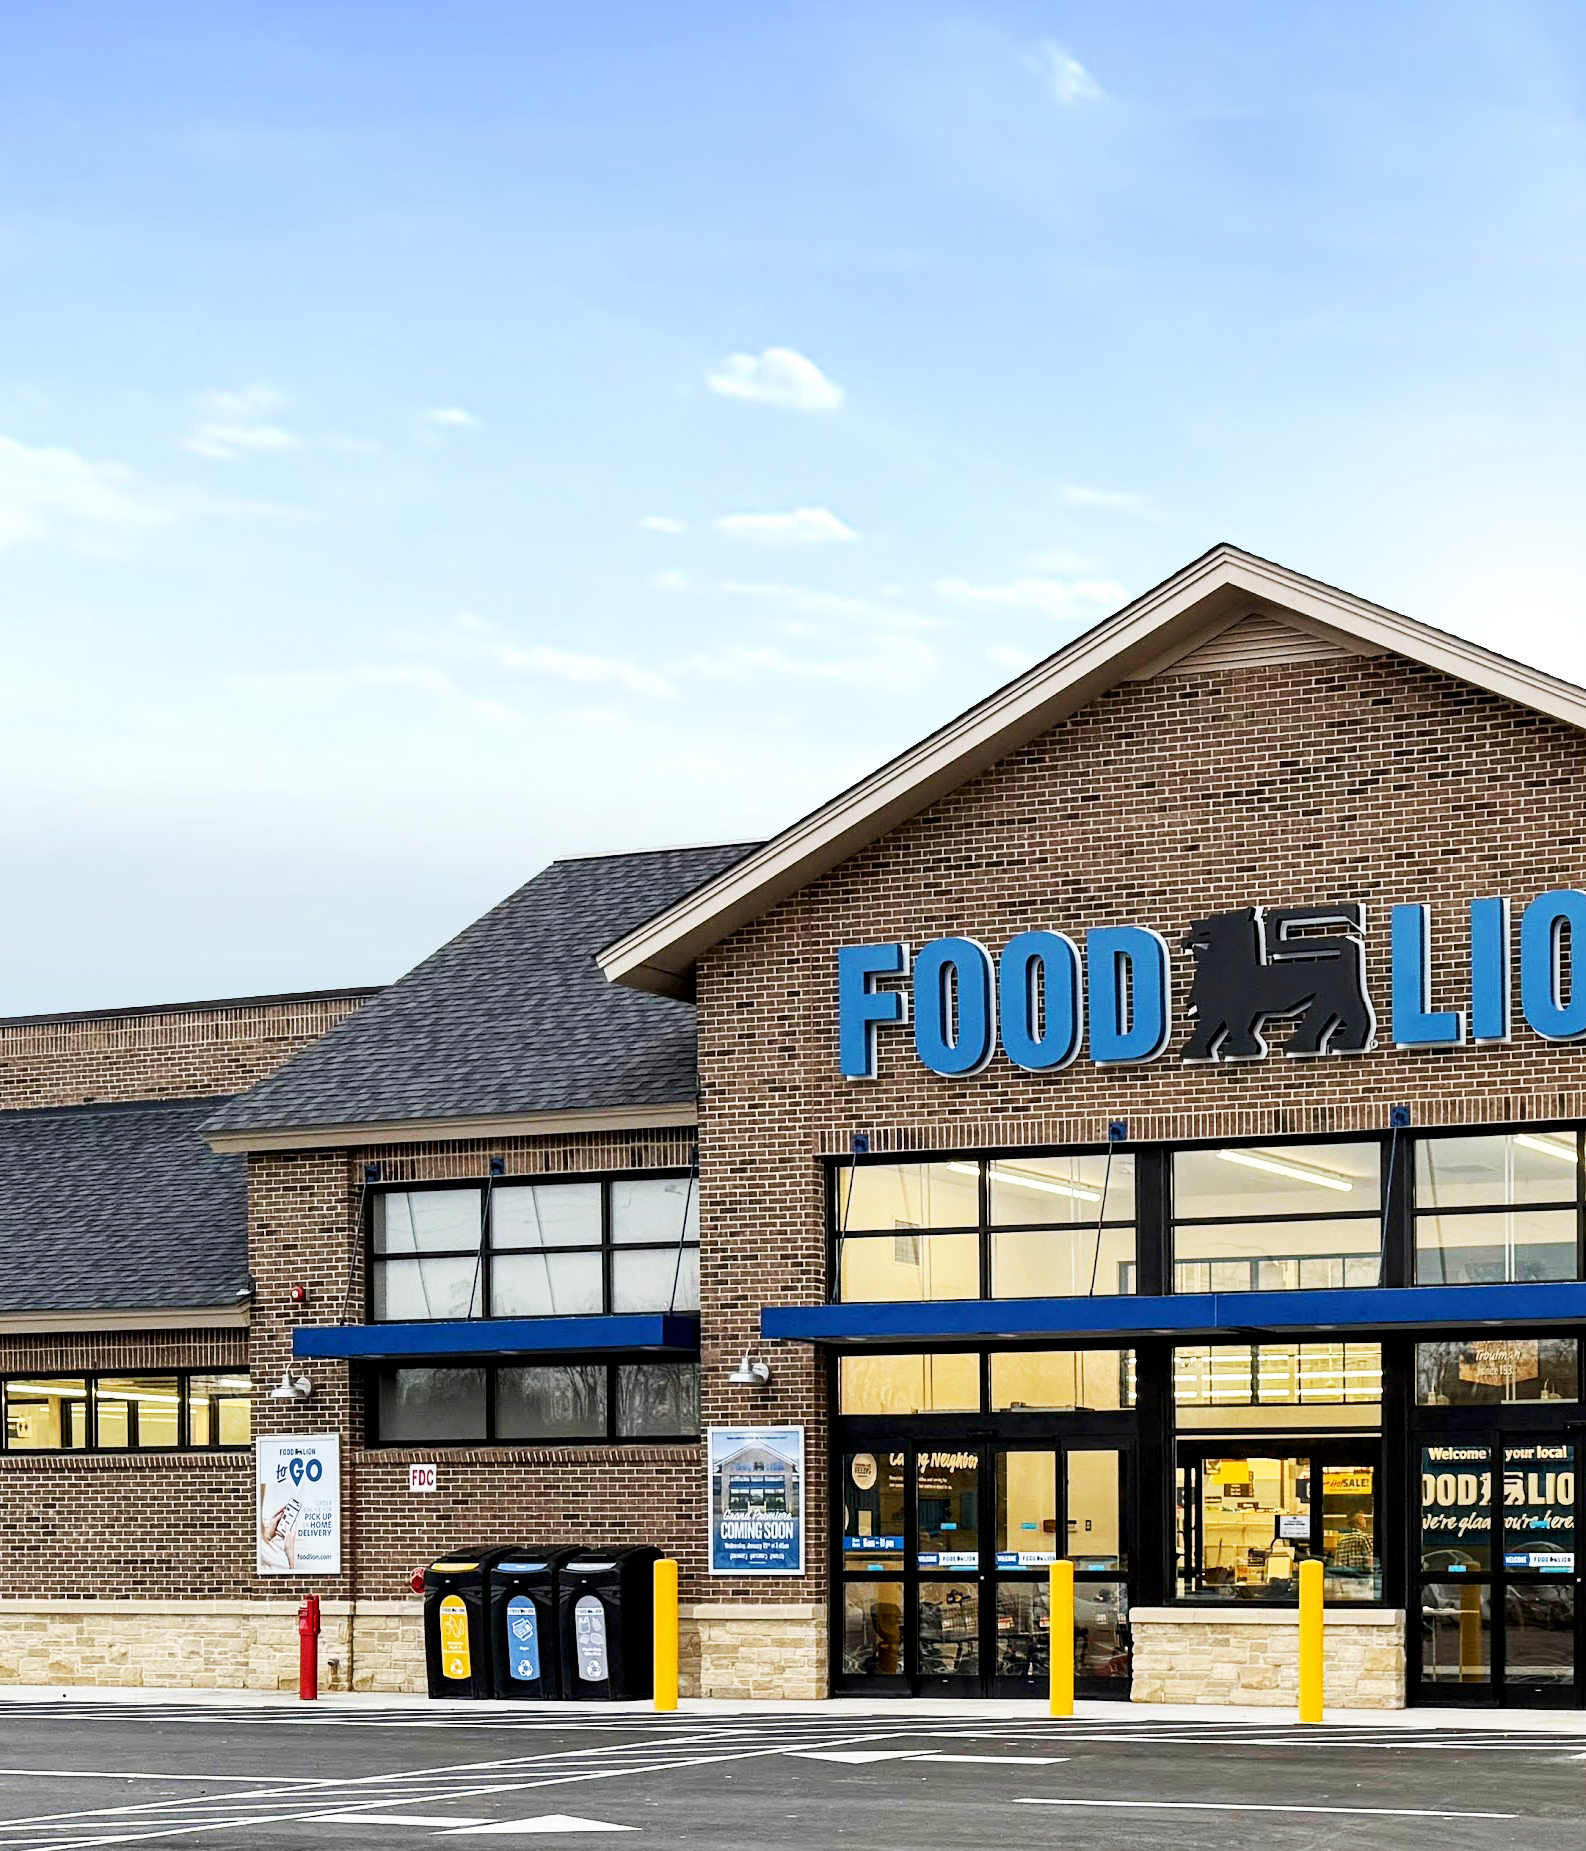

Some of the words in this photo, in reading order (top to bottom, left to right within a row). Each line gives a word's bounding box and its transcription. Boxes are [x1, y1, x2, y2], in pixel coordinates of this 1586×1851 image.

[836, 925, 1173, 1081] FOOD
[279, 1448, 294, 1456] FOOD
[301, 1448, 316, 1456] LION
[1428, 1447, 1487, 1461] Welcome
[1505, 1448, 1535, 1462] your
[1537, 1445, 1568, 1460] local
[276, 1464, 288, 1480] to
[289, 1458, 323, 1487] GO
[412, 1469, 434, 1486] FDC
[1422, 1473, 1478, 1506] OOD
[298, 1529, 332, 1537] DELIVERY
[310, 1521, 332, 1529] HOME
[721, 1521, 762, 1540] COMING
[763, 1521, 794, 1540] SOON
[297, 1553, 332, 1561] foodlion.com
